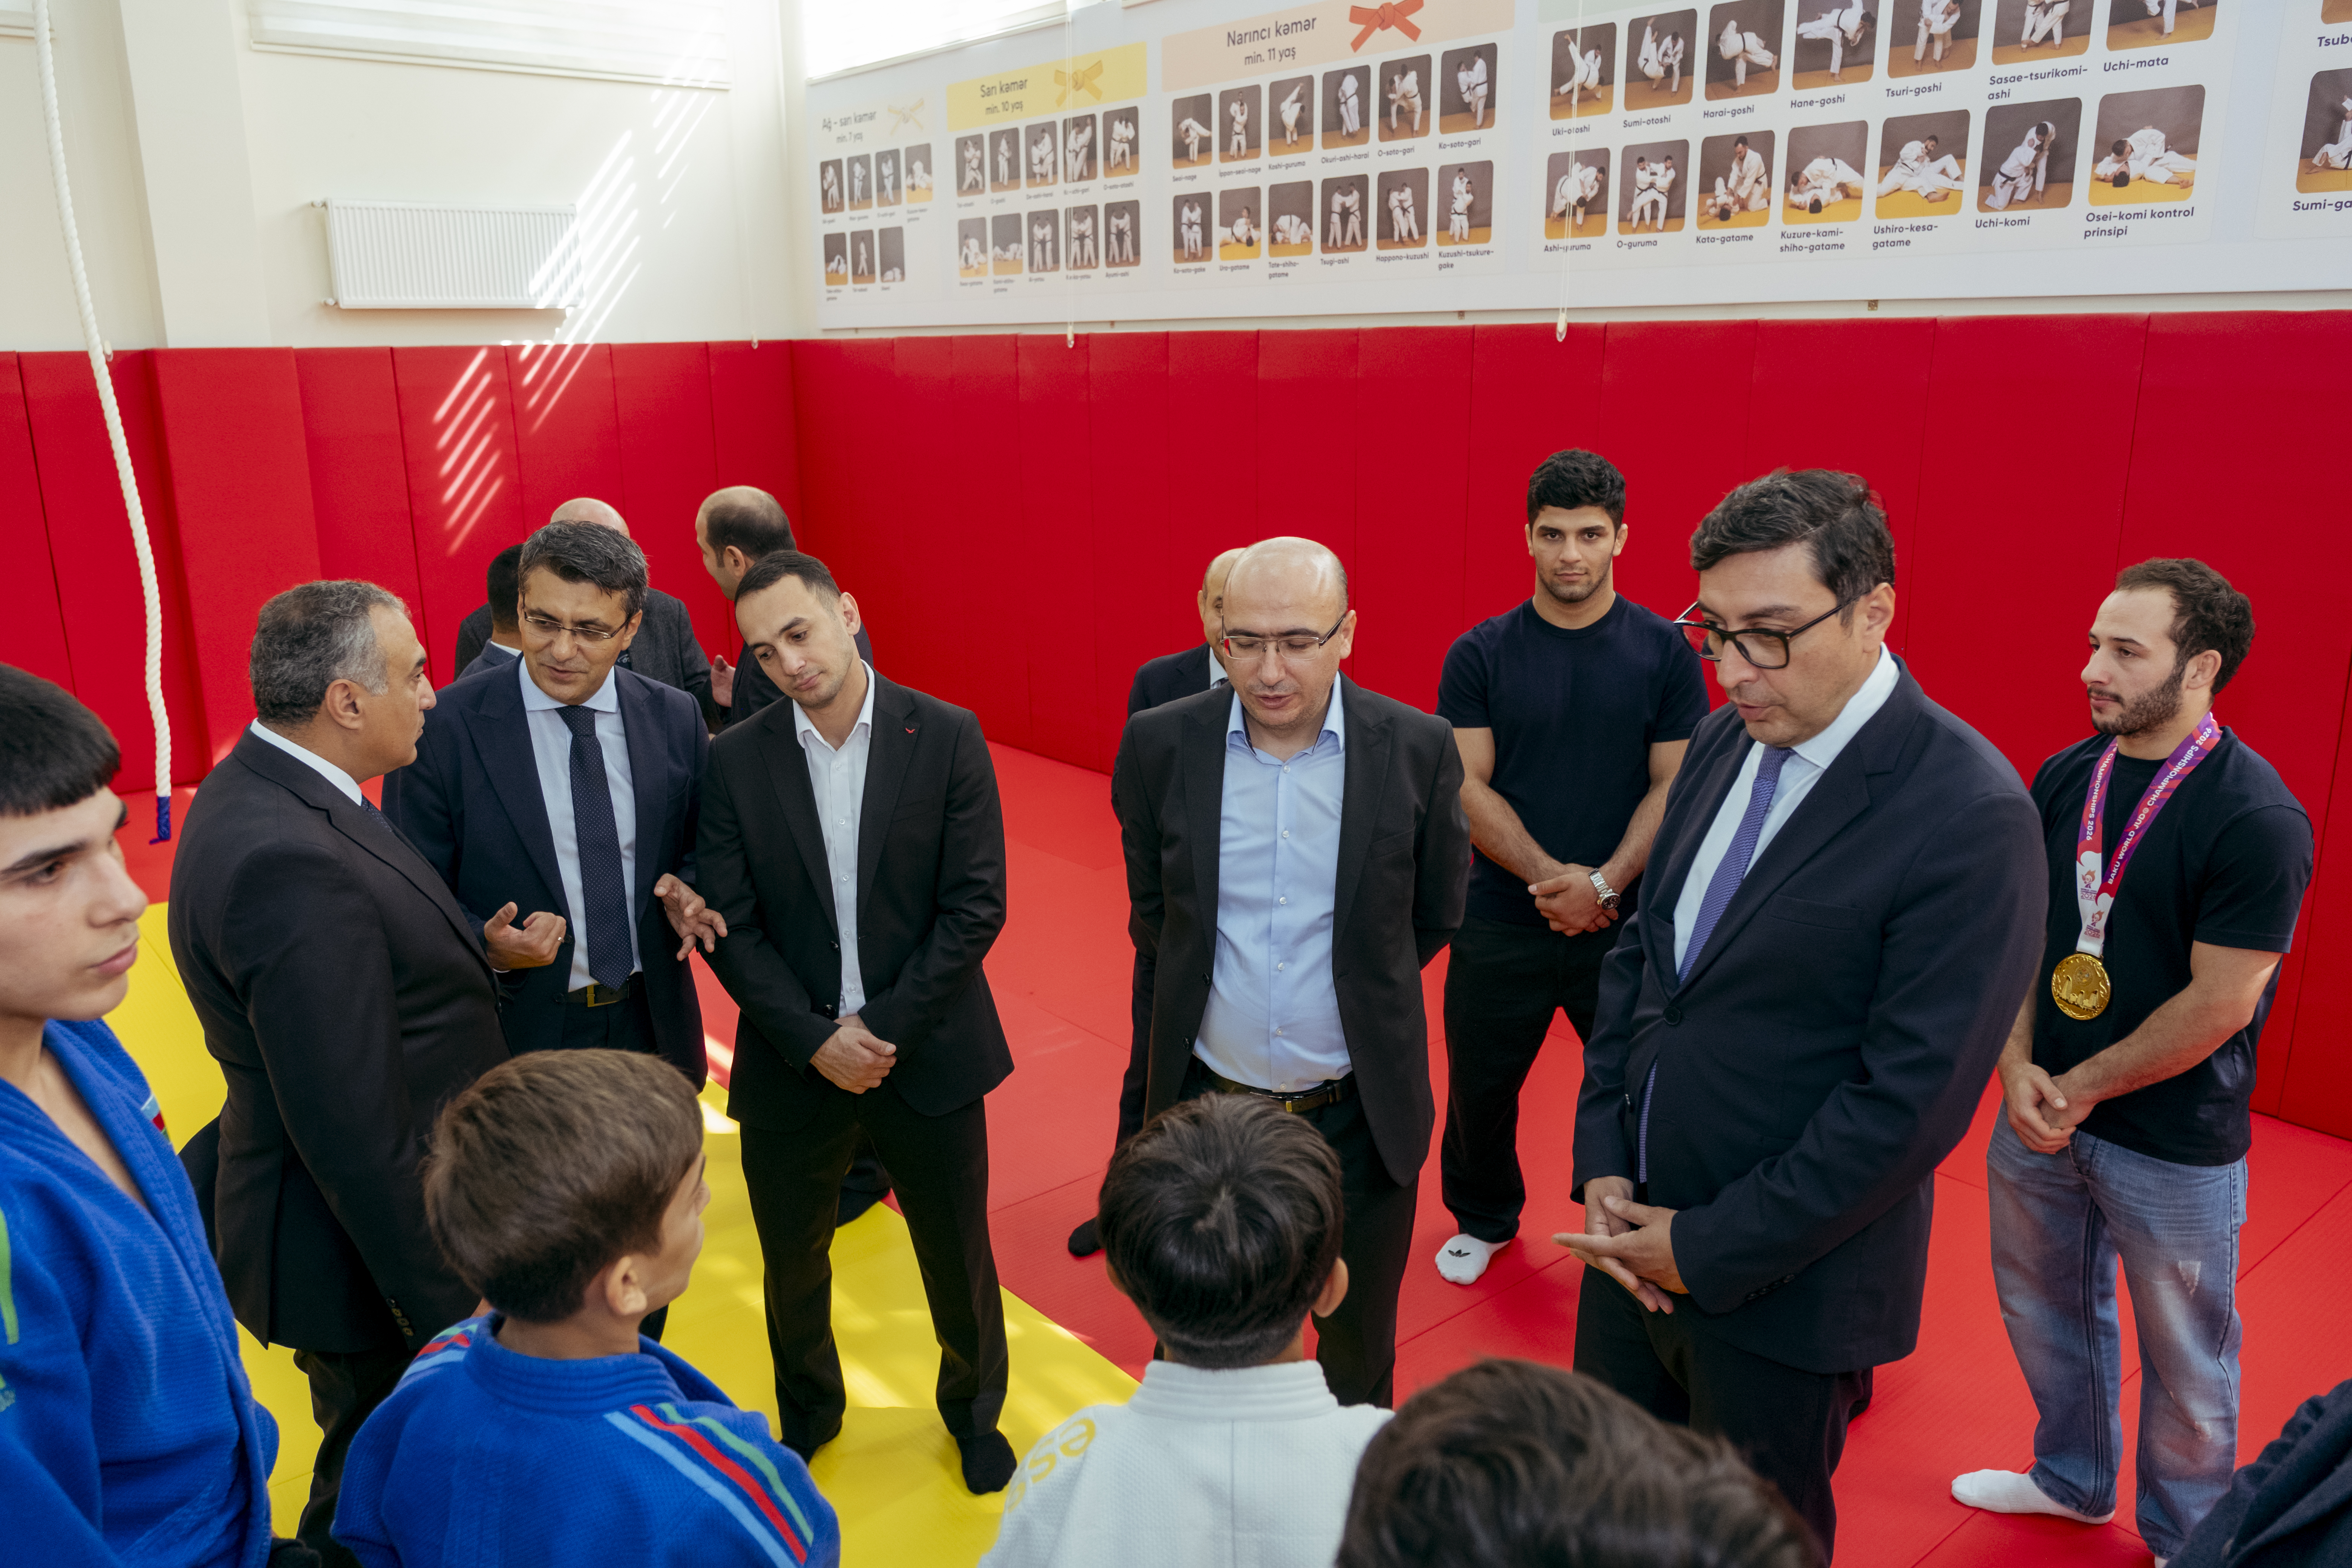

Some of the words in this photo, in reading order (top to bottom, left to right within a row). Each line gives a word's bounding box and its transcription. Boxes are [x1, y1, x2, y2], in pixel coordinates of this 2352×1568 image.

[1227, 27, 1271, 47] Narıncı
[1275, 17, 1317, 37] kəmər
[1244, 51, 1265, 65] min.
[1268, 47, 1276, 60] 11
[1278, 47, 1296, 62] yaş
[2103, 57, 2169, 72] Uchi-mata
[1989, 66, 2088, 85] Sasae-tsurikomi-
[1886, 82, 1942, 97] Tsuri-goshi
[1988, 89, 2011, 100] ashi
[1001, 101, 1009, 112] 10
[1011, 101, 1023, 113] yaş
[1790, 94, 1845, 109] Hane-goshi
[1703, 104, 1754, 118] Harai-goshi
[1623, 115, 1671, 128] Sumi-otoshi
[1438, 138, 1481, 149] Ko-soto-gari
[1377, 146, 1415, 157] O-soto-gari
[2086, 210, 2147, 222] Osei-komi
[2150, 207, 2194, 219] kontrol
[1975, 216, 2030, 228] Uchi-komi
[1781, 228, 1843, 239] Kuzure-kami-
[1874, 224, 1938, 234] Ushiro-kesa-
[2084, 225, 2128, 240] prinsipi
[1617, 240, 1658, 250] O-guruma
[1696, 234, 1754, 245] Kata-gatame
[1872, 239, 1911, 250] gatame
[1438, 249, 1494, 258] Kuzushi-tsukure-
[1780, 243, 1845, 253] shiho-gatame
[1438, 262, 1454, 271] gake
[2089, 753, 2114, 819] CHAMPIONSHIPS
[2107, 861, 2120, 885] BAKU
[2118, 830, 2135, 859] WORLD
[2147, 745, 2199, 806] CHAMPIONSHIPS
[2196, 727, 2212, 746] 2026
